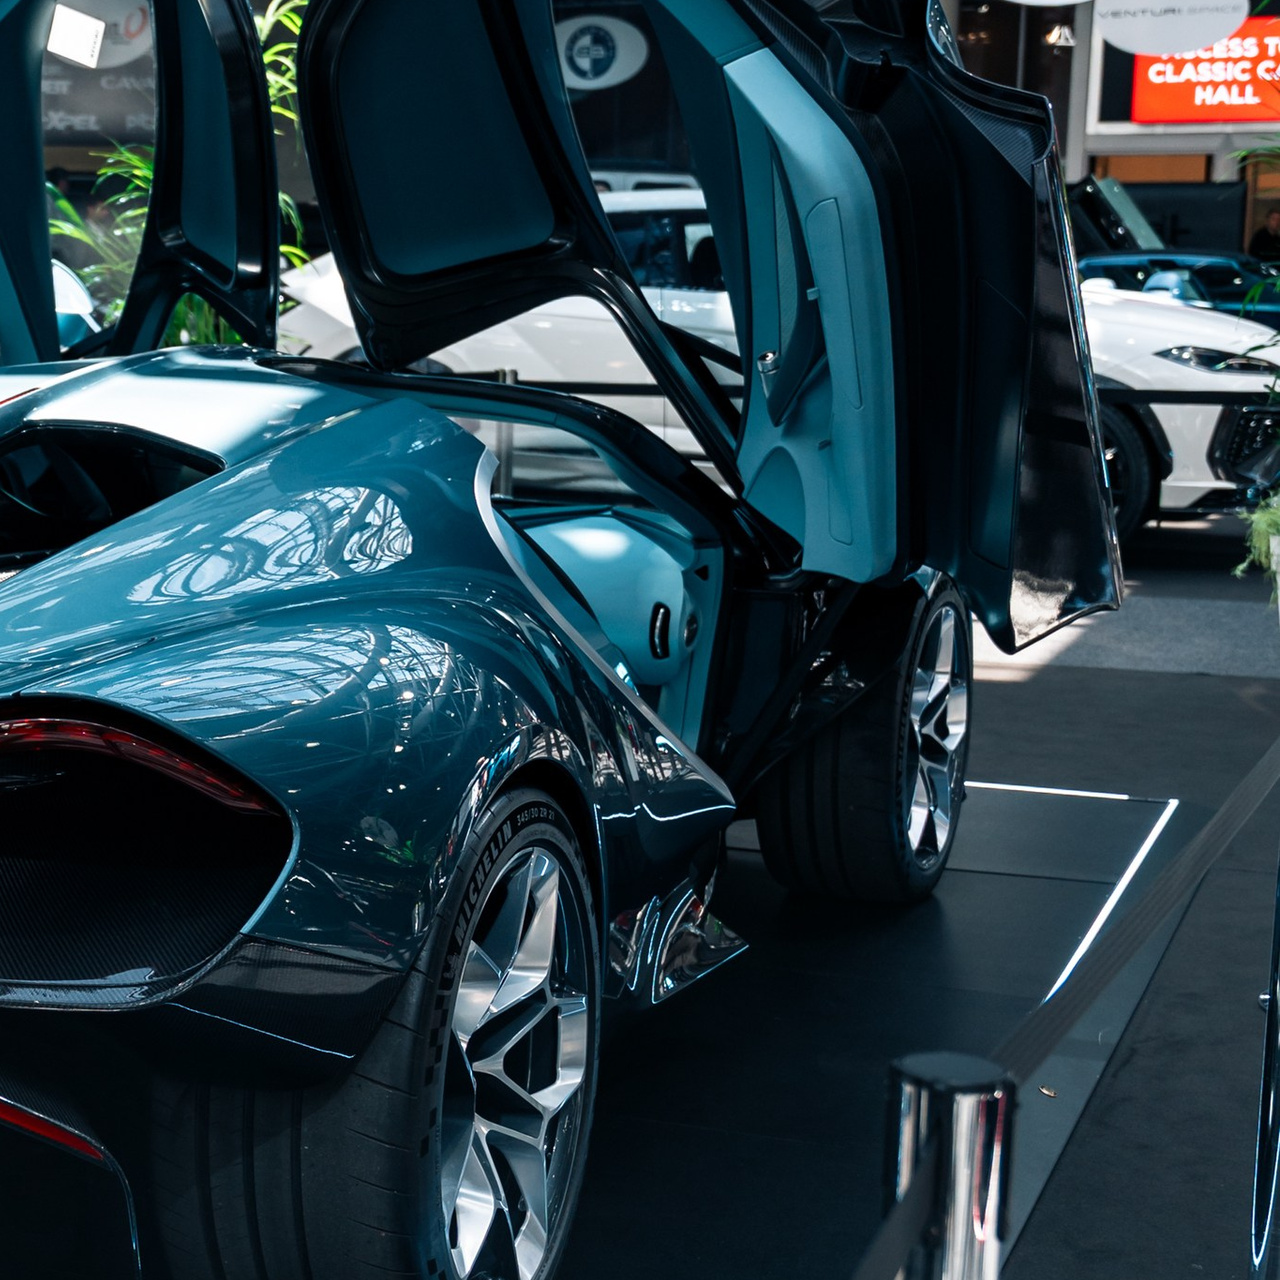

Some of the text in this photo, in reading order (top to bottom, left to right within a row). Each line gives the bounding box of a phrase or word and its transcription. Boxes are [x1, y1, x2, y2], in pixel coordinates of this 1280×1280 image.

[1148, 61, 1253, 84] CLASSIC
[1194, 83, 1261, 106] HALL
[454, 820, 513, 947] MICHELIN
